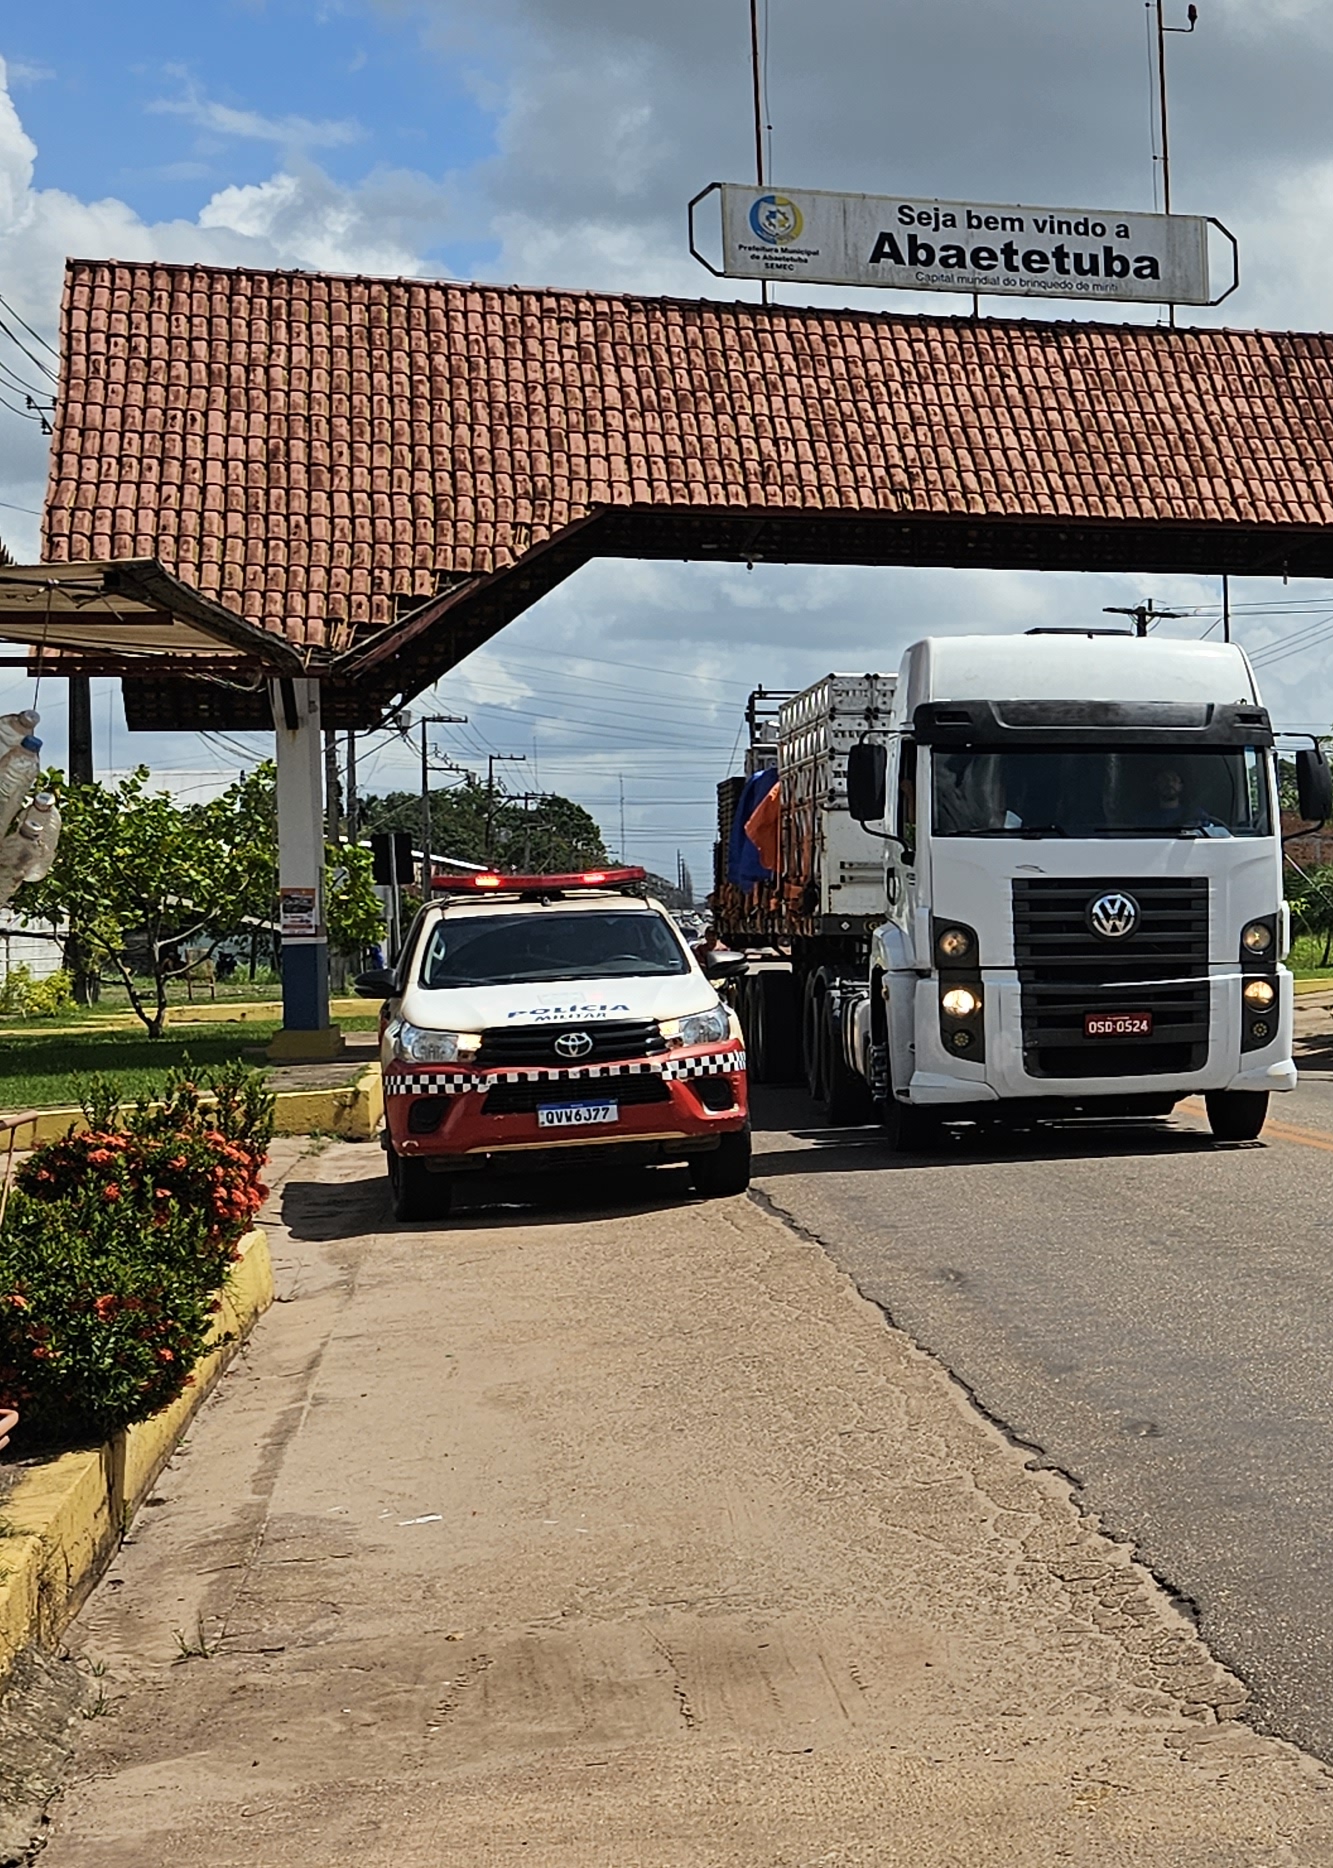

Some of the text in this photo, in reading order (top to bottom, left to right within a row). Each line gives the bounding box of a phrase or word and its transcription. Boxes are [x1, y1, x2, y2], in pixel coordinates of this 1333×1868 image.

[898, 204, 1130, 239] Seja bem vindo a
[738, 243, 820, 257] Prefeitura Municipal
[869, 231, 1161, 280] Abaetetuba
[915, 271, 954, 284] Capital
[957, 275, 1000, 285] mundial
[1002, 277, 1017, 287] do
[1019, 278, 1074, 290] brinquedo
[1075, 281, 1090, 291] de
[507, 1004, 630, 1018] POLÍCIA
[535, 1012, 607, 1022] MILITAR
